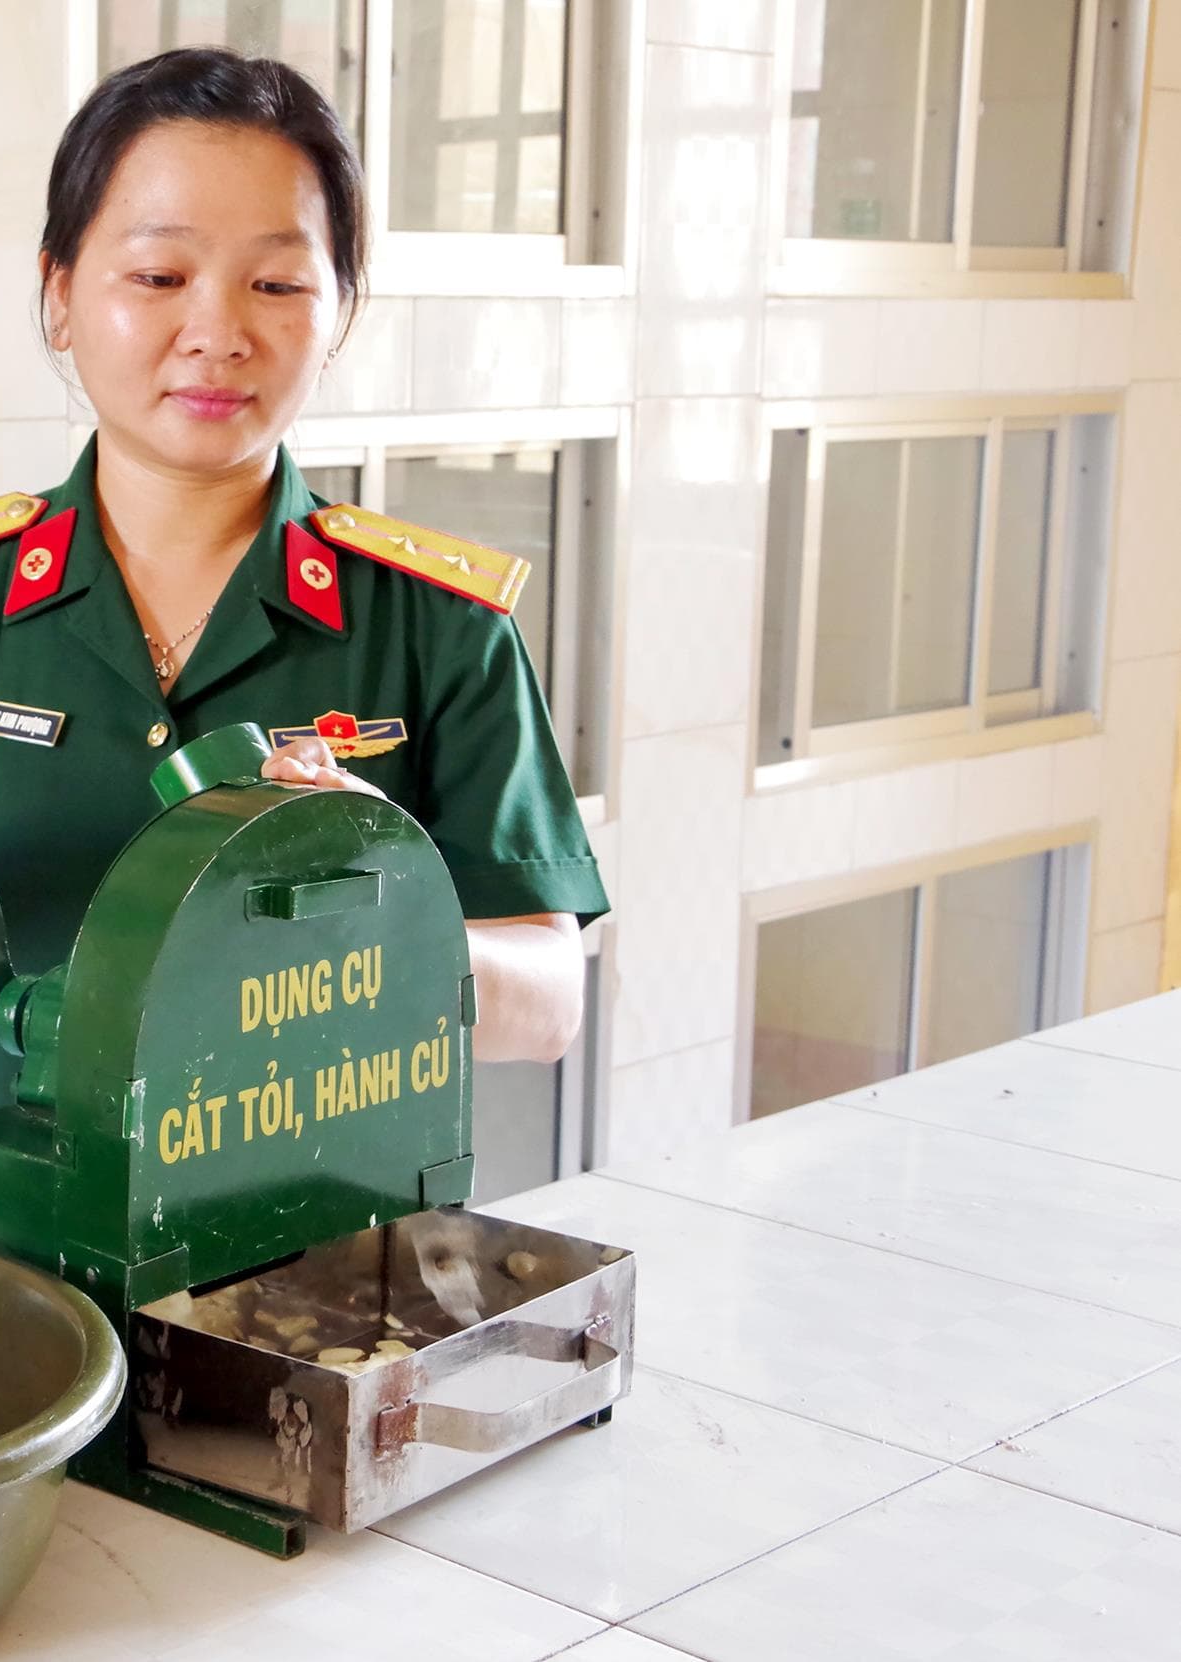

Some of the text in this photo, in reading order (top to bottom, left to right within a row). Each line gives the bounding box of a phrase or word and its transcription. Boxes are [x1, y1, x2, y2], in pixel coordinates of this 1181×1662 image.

[241, 944, 383, 1038] DỤNG CỤ
[158, 1016, 450, 1165] CẮT TỎI, HÀNH CỦ
